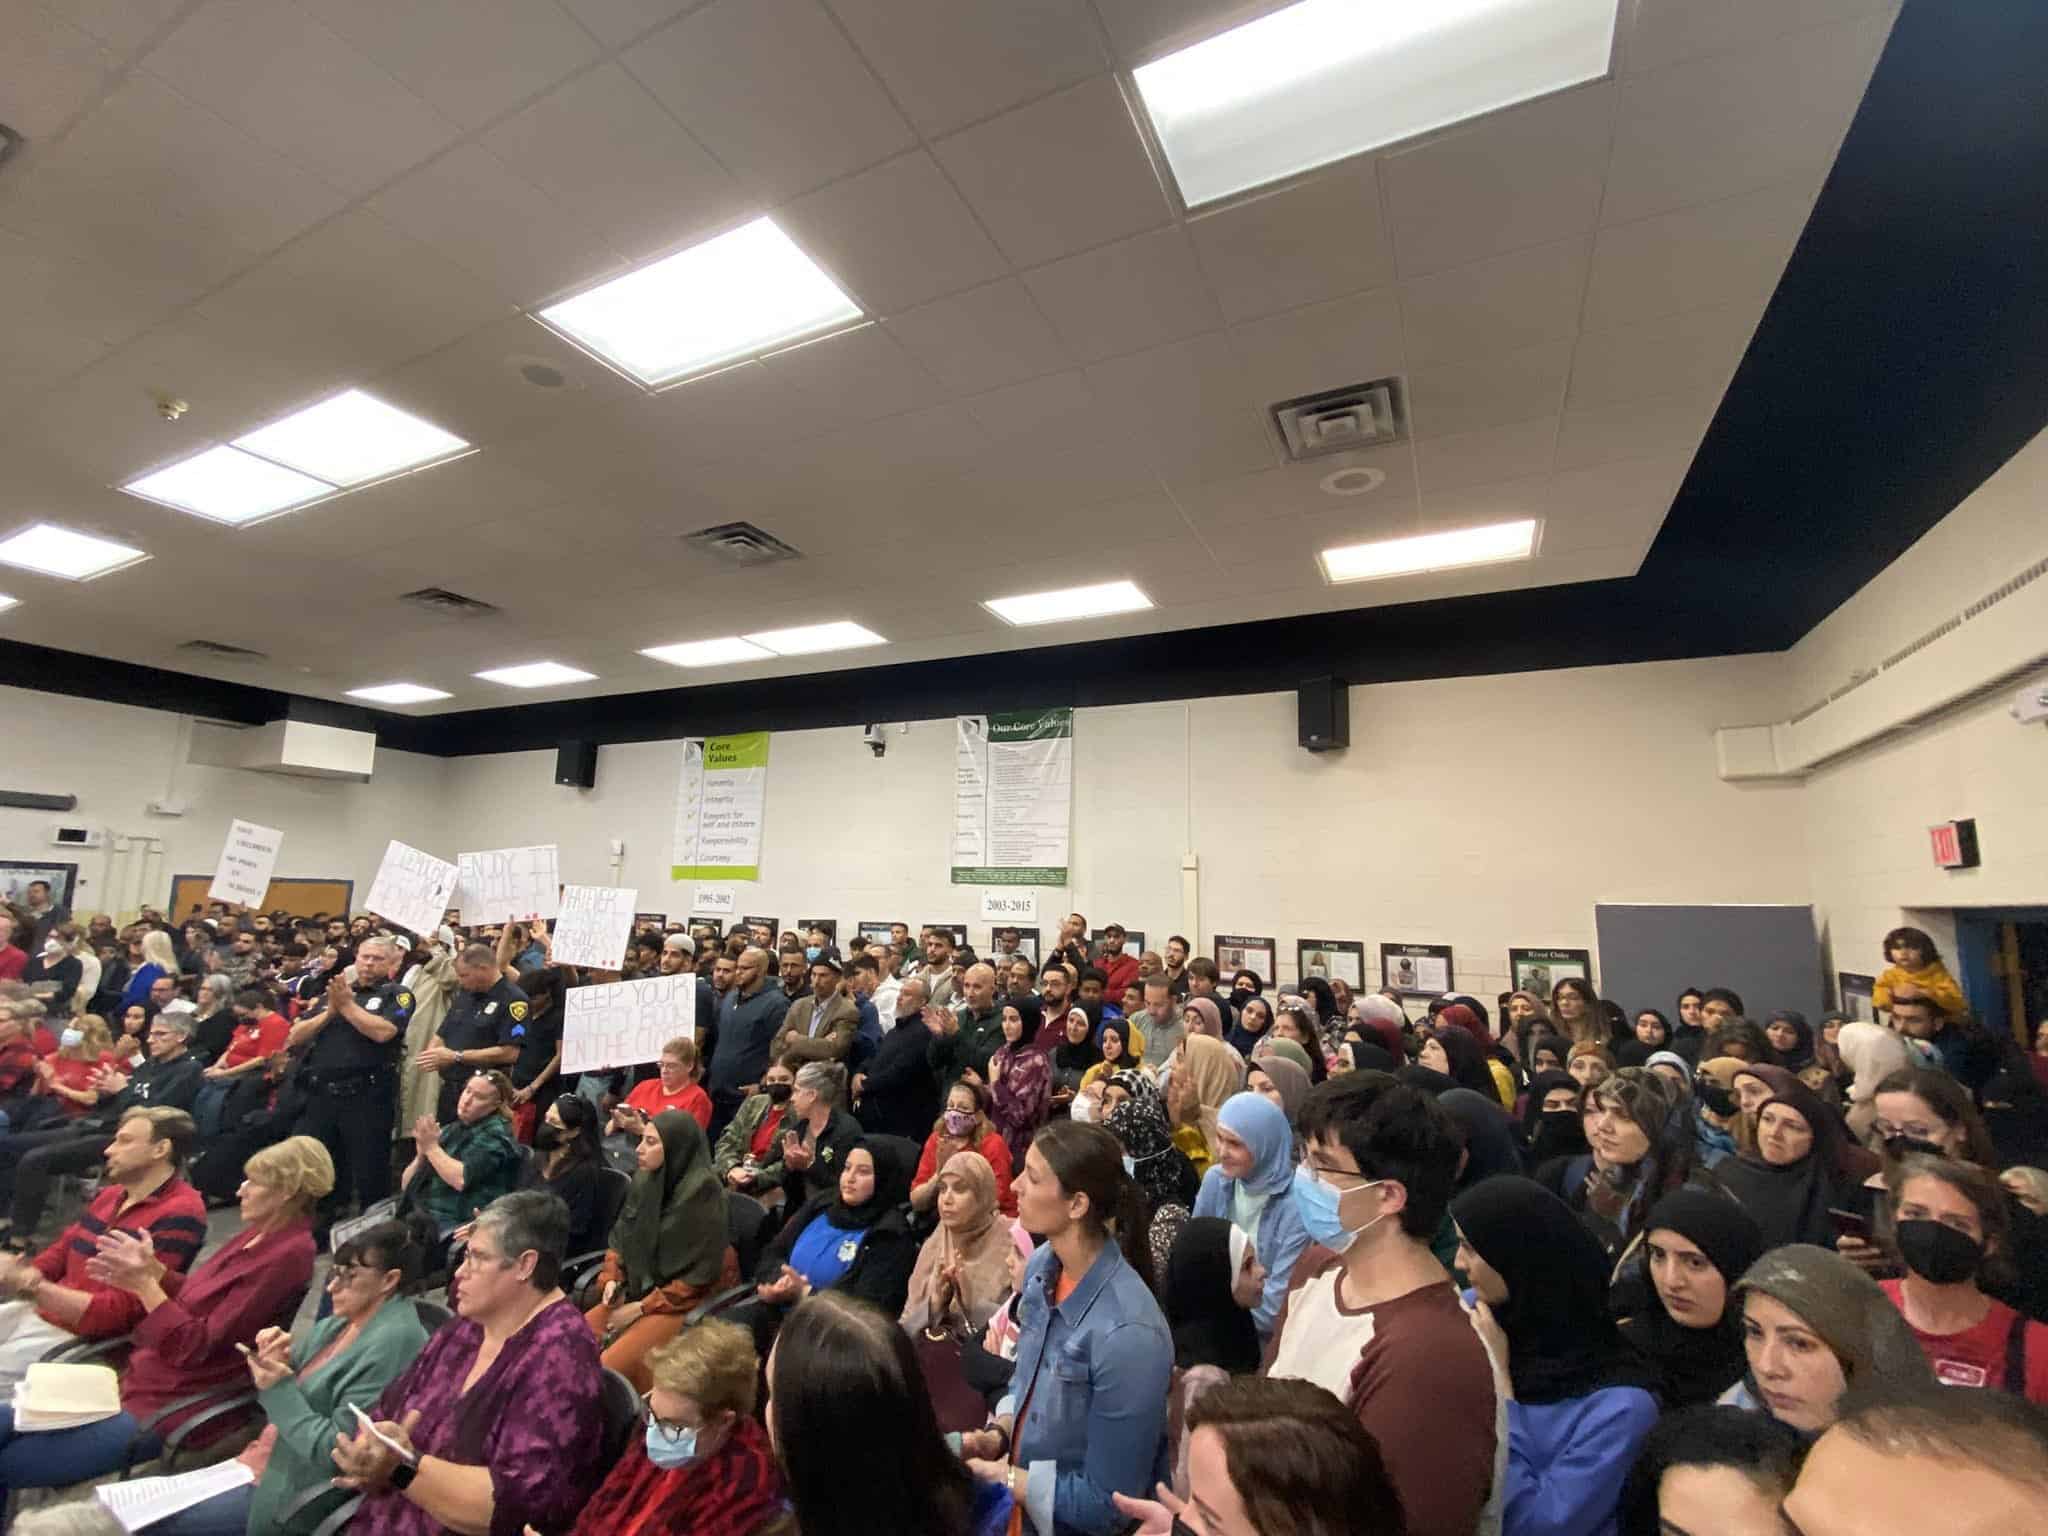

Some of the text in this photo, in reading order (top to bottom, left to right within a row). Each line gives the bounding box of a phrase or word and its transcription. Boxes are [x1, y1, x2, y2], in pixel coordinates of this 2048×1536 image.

[1013, 721, 1036, 732] Core
[710, 742, 731, 752] Core
[708, 753, 737, 763] Values
[986, 899, 1032, 912] 2003-2015
[567, 974, 690, 1012] KEEP YOUR
